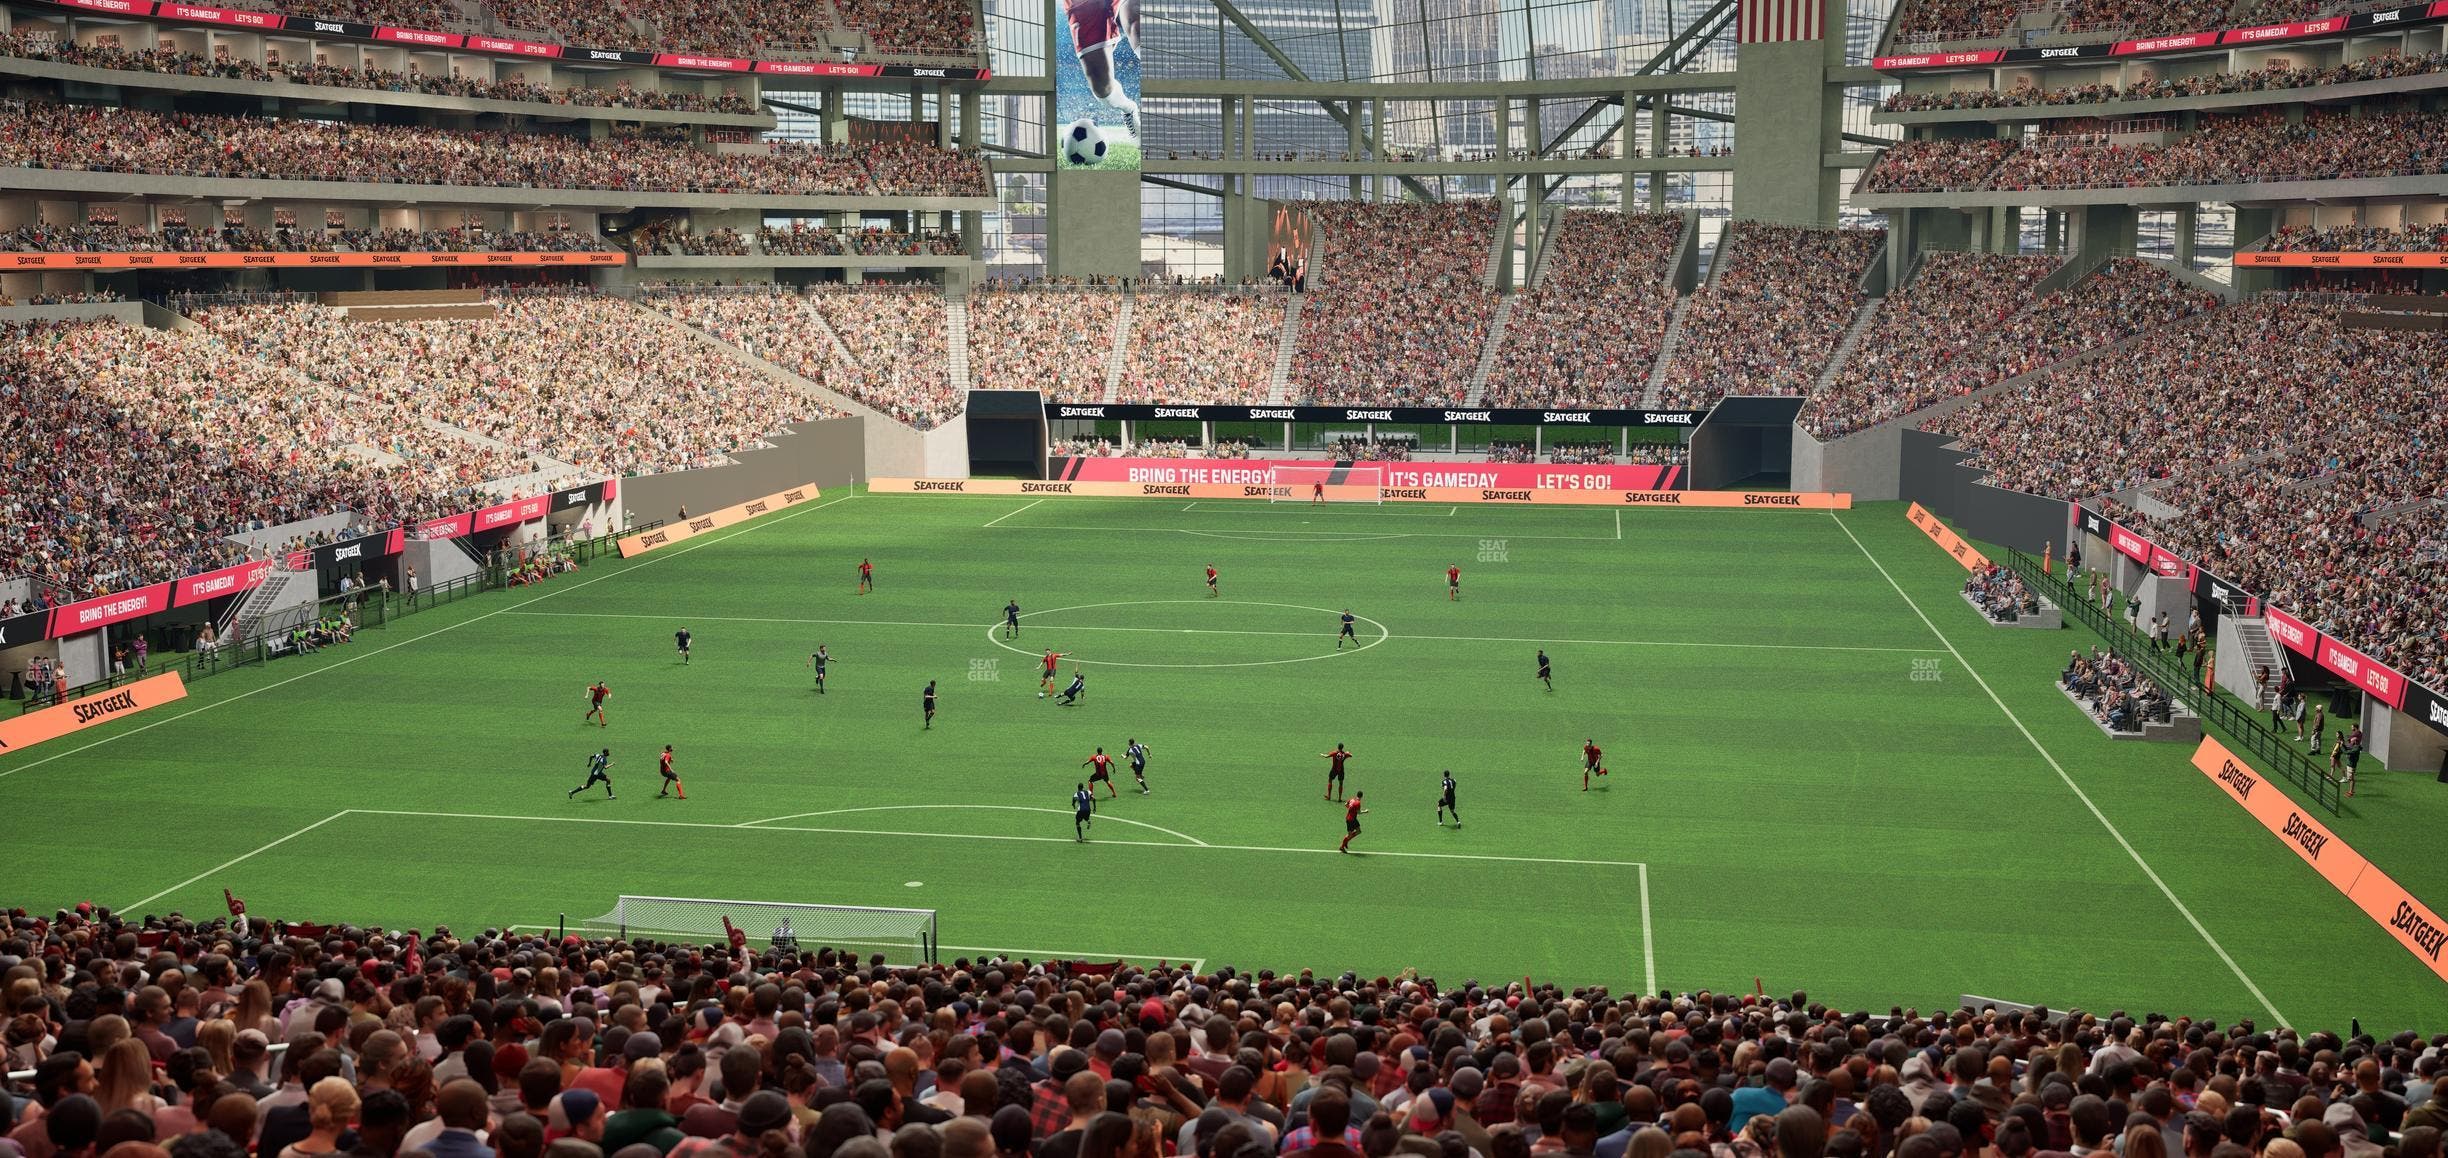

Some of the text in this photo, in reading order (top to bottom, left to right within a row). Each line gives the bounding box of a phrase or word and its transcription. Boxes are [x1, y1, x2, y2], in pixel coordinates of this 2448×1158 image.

[190, 9, 220, 19] GAMEDAY
[235, 14, 252, 23] LET'S
[2373, 10, 2399, 23] SEATGEEK
[315, 21, 344, 33] SEATGEEK
[2242, 31, 2254, 39] IT'S
[2256, 27, 2288, 38] GAMEDAY
[2305, 24, 2320, 33] LET'S
[2136, 37, 2195, 50] BRING THE ENERGY!
[591, 50, 621, 60] SEATGEEK
[2041, 47, 2079, 57] SEATGEEK
[914, 68, 945, 77] SEATGEEK
[18, 257, 45, 265] SEATGEEK
[75, 256, 101, 264] SEATGEEK
[129, 256, 153, 264] SEATGEEK
[310, 255, 339, 263] SEATGEEK
[2373, 256, 2403, 264] SEATGEEK
[1061, 407, 1104, 417] SEATGEEK
[1155, 408, 1199, 418] SEATGEEK
[1250, 409, 1295, 419] SEATGEEK
[1347, 410, 1392, 420] SEATGEEK
[1445, 411, 1490, 421] SEATGEEK
[1544, 412, 1590, 422] SEATGEEK
[1645, 413, 1691, 424] SEATGEEK
[1129, 467, 1276, 484] BRING THE ENERGY!
[1390, 471, 1612, 489] IT'S GAMEDAY LET'S GO!
[914, 481, 963, 491] SEATGEEK
[1021, 482, 1072, 493] SEATGEEK
[1143, 484, 1190, 495] SEATGEEK
[1381, 489, 1426, 499] SEATGEEK
[1483, 490, 1531, 501] SEATGEEK
[1626, 493, 1680, 503] SEATGEEK
[1745, 495, 1800, 505] SEATGEEK
[690, 516, 715, 533] SEATGEEK
[641, 531, 669, 548] SEATGEEK
[335, 543, 361, 561] SEATGEEK
[193, 582, 206, 595] IT'S
[206, 575, 234, 592] GAMEDAY
[80, 596, 147, 623] BRING THE ENERGY!
[2366, 667, 2380, 690] LET'S
[73, 690, 137, 723] SEATGEEK
[2218, 759, 2256, 800] SEATGEEK
[2283, 812, 2328, 860] SEATGEEK
[2390, 901, 2448, 962] SEATGEEK
